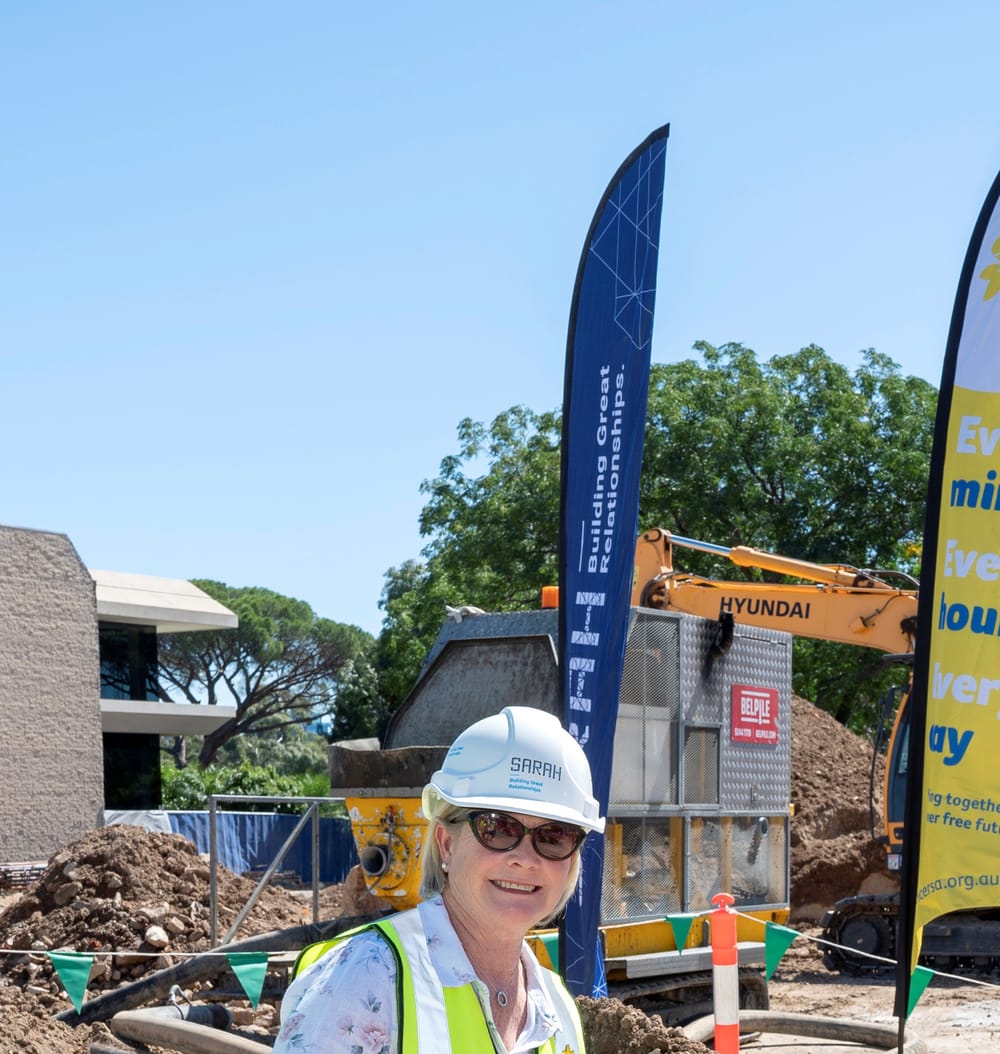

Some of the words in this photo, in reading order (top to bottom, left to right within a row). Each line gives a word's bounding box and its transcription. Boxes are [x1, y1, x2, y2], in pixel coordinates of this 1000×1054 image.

[596, 364, 610, 446] Great
[599, 363, 625, 574] Relationships.
[587, 455, 608, 573] Building
[720, 596, 811, 619] HYUNDAI
[928, 723, 974, 766] ay
[510, 757, 562, 782] SARAH
[942, 811, 972, 830] free
[918, 873, 1000, 901] cersa.org.au
